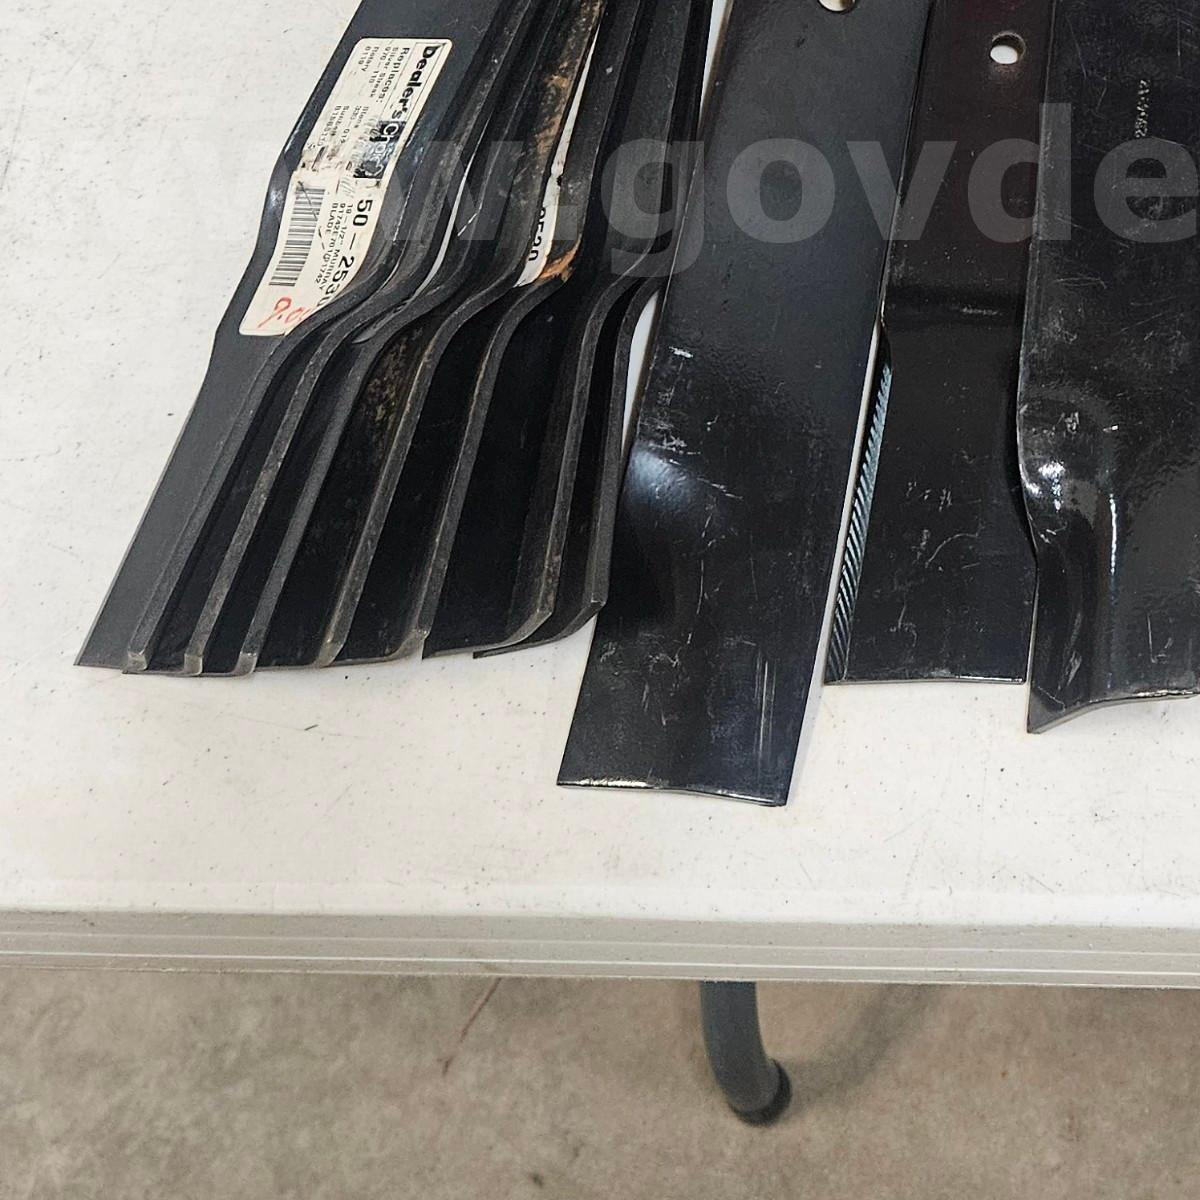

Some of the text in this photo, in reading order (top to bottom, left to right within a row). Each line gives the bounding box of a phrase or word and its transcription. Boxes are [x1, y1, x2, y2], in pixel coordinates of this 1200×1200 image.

[360, 46, 380, 72] Rotary
[376, 47, 410, 103] Replaces:
[392, 45, 442, 119] Dealer's
[326, 202, 338, 235] BLADE
[352, 199, 373, 227] 50
